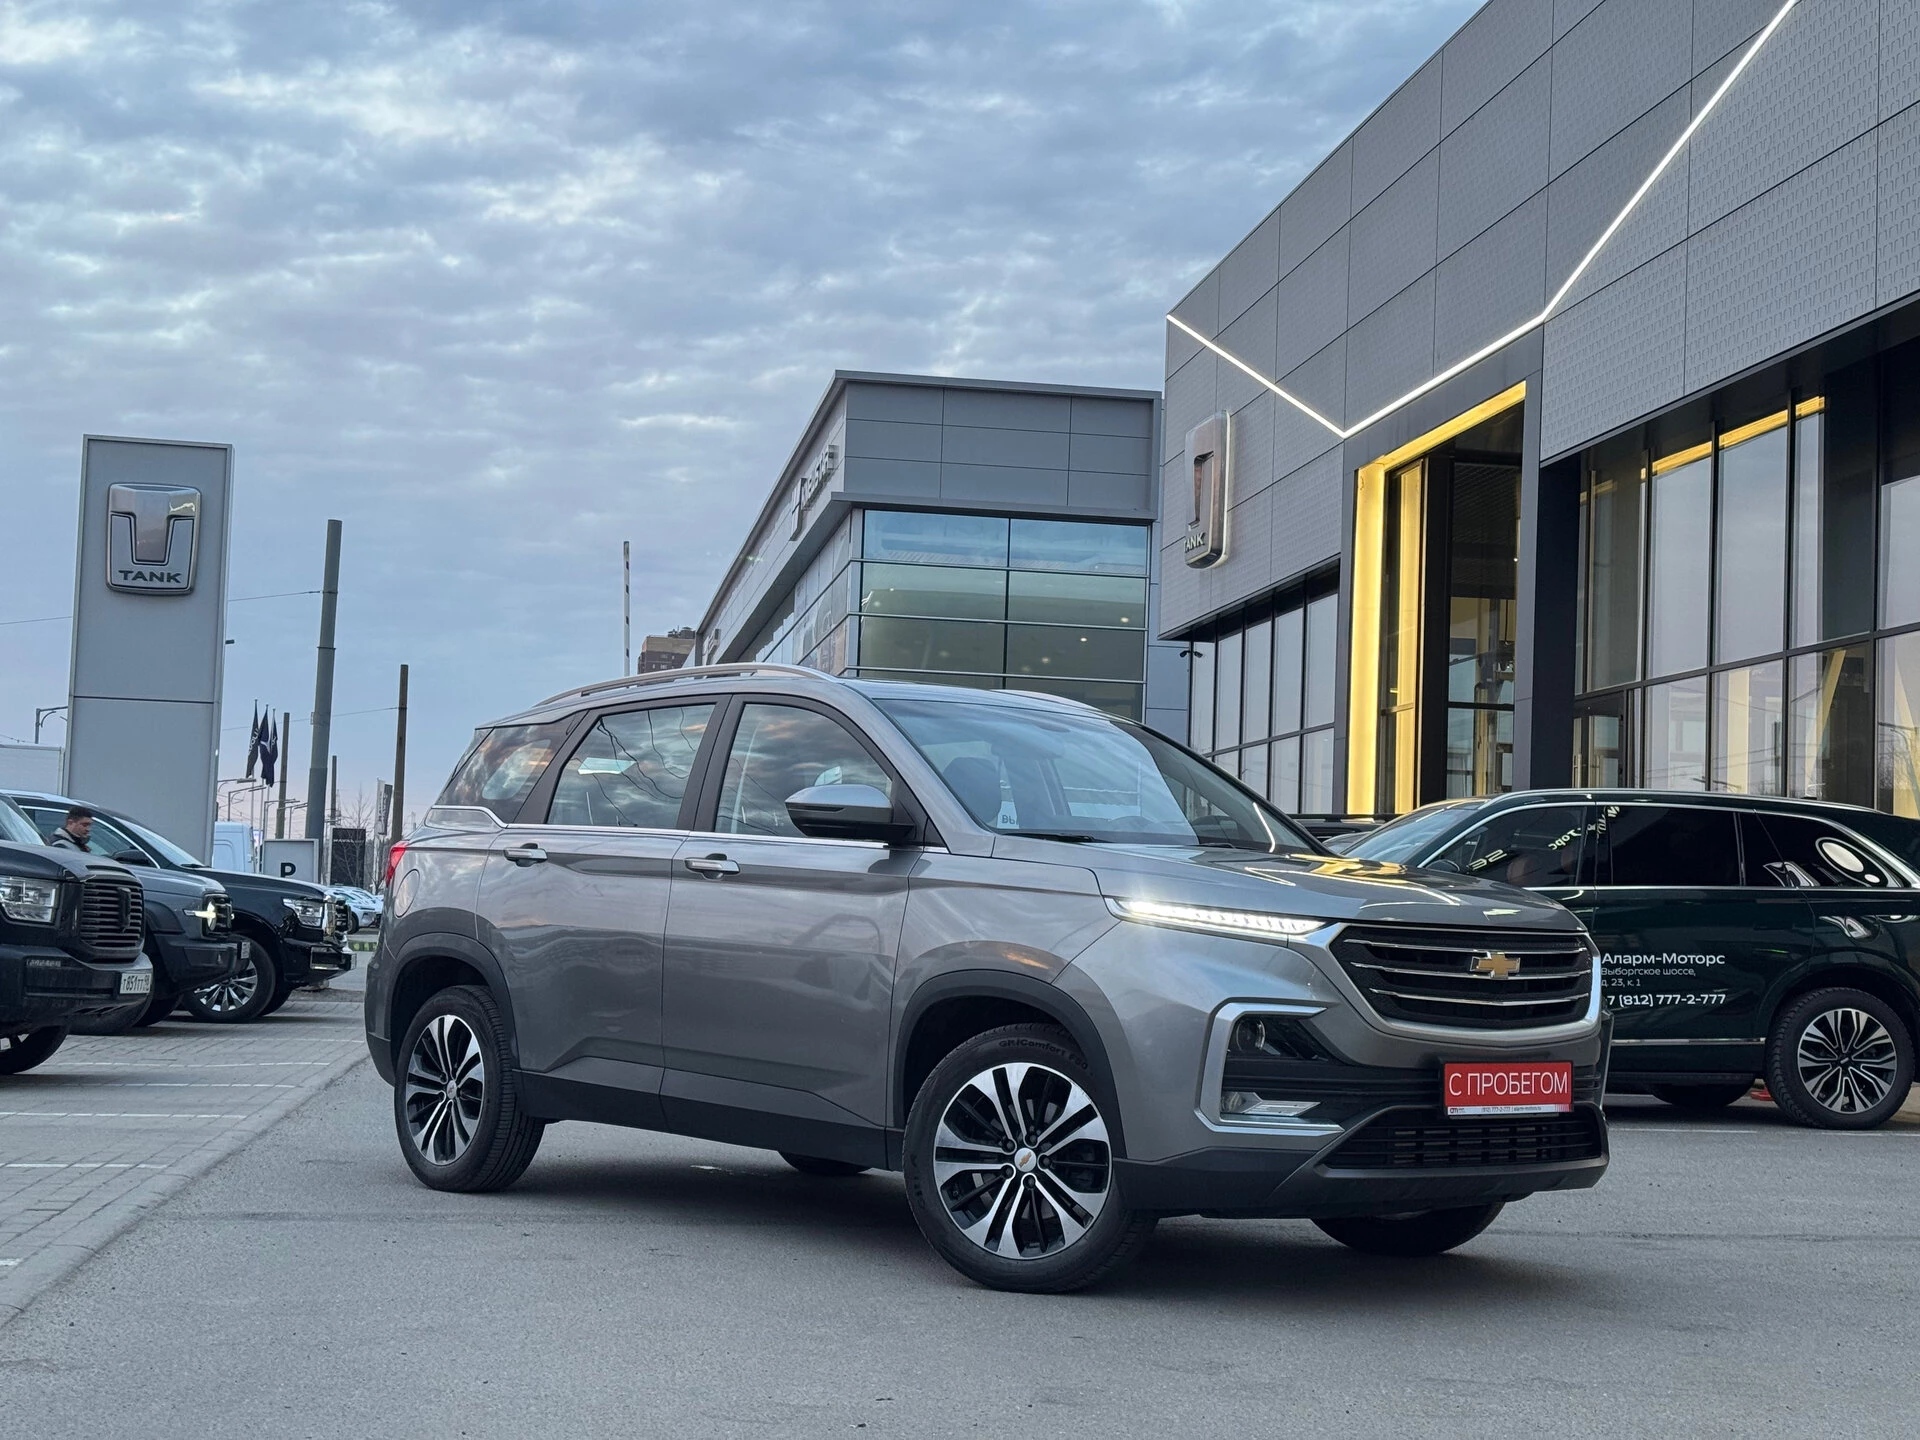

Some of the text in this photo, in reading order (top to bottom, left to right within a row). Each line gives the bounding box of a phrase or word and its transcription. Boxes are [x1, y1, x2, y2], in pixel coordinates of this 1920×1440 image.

[118, 569, 182, 584] TANK
[280, 862, 297, 879] P
[1601, 952, 1726, 967] Аларм-Моторс
[1601, 967, 1696, 977] Выборгское шоссе,
[1611, 978, 1625, 988] 23,
[1636, 978, 1641, 987] 1
[1619, 993, 1654, 1008] (812)
[1655, 994, 1726, 1005] 777-2-777
[1448, 1071, 1568, 1096] С ПРОБЕГОМ
